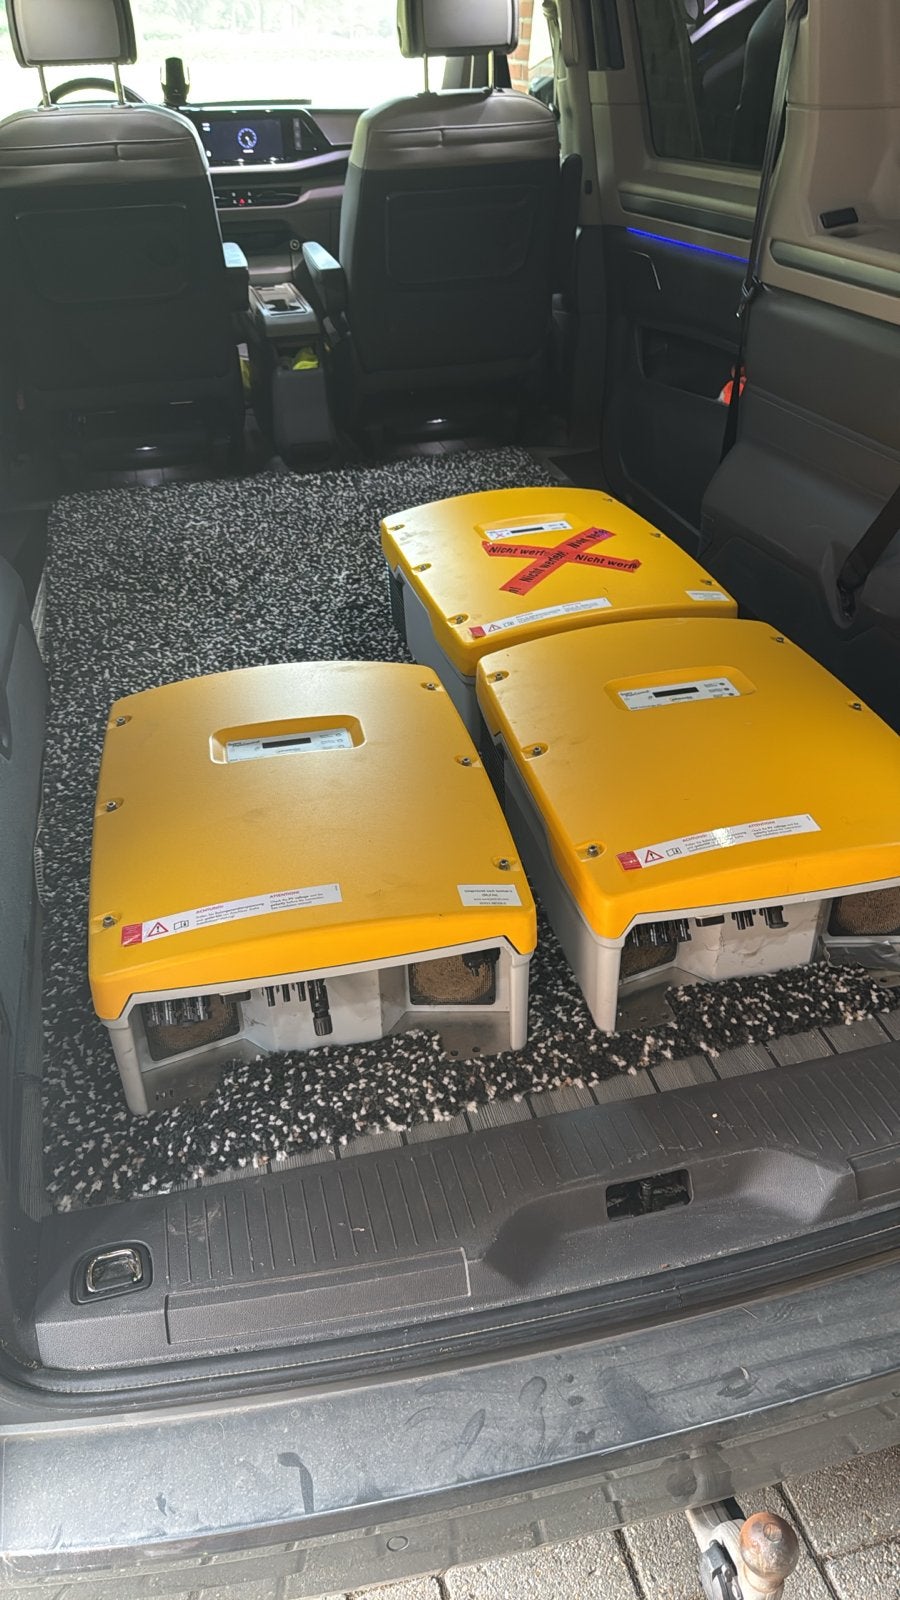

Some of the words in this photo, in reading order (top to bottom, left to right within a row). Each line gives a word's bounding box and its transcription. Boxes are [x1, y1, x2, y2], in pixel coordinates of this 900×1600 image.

[489, 546, 518, 554] Nicht
[520, 549, 549, 557] werf
[574, 554, 606, 565] Nicht
[519, 567, 545, 582] Nicht
